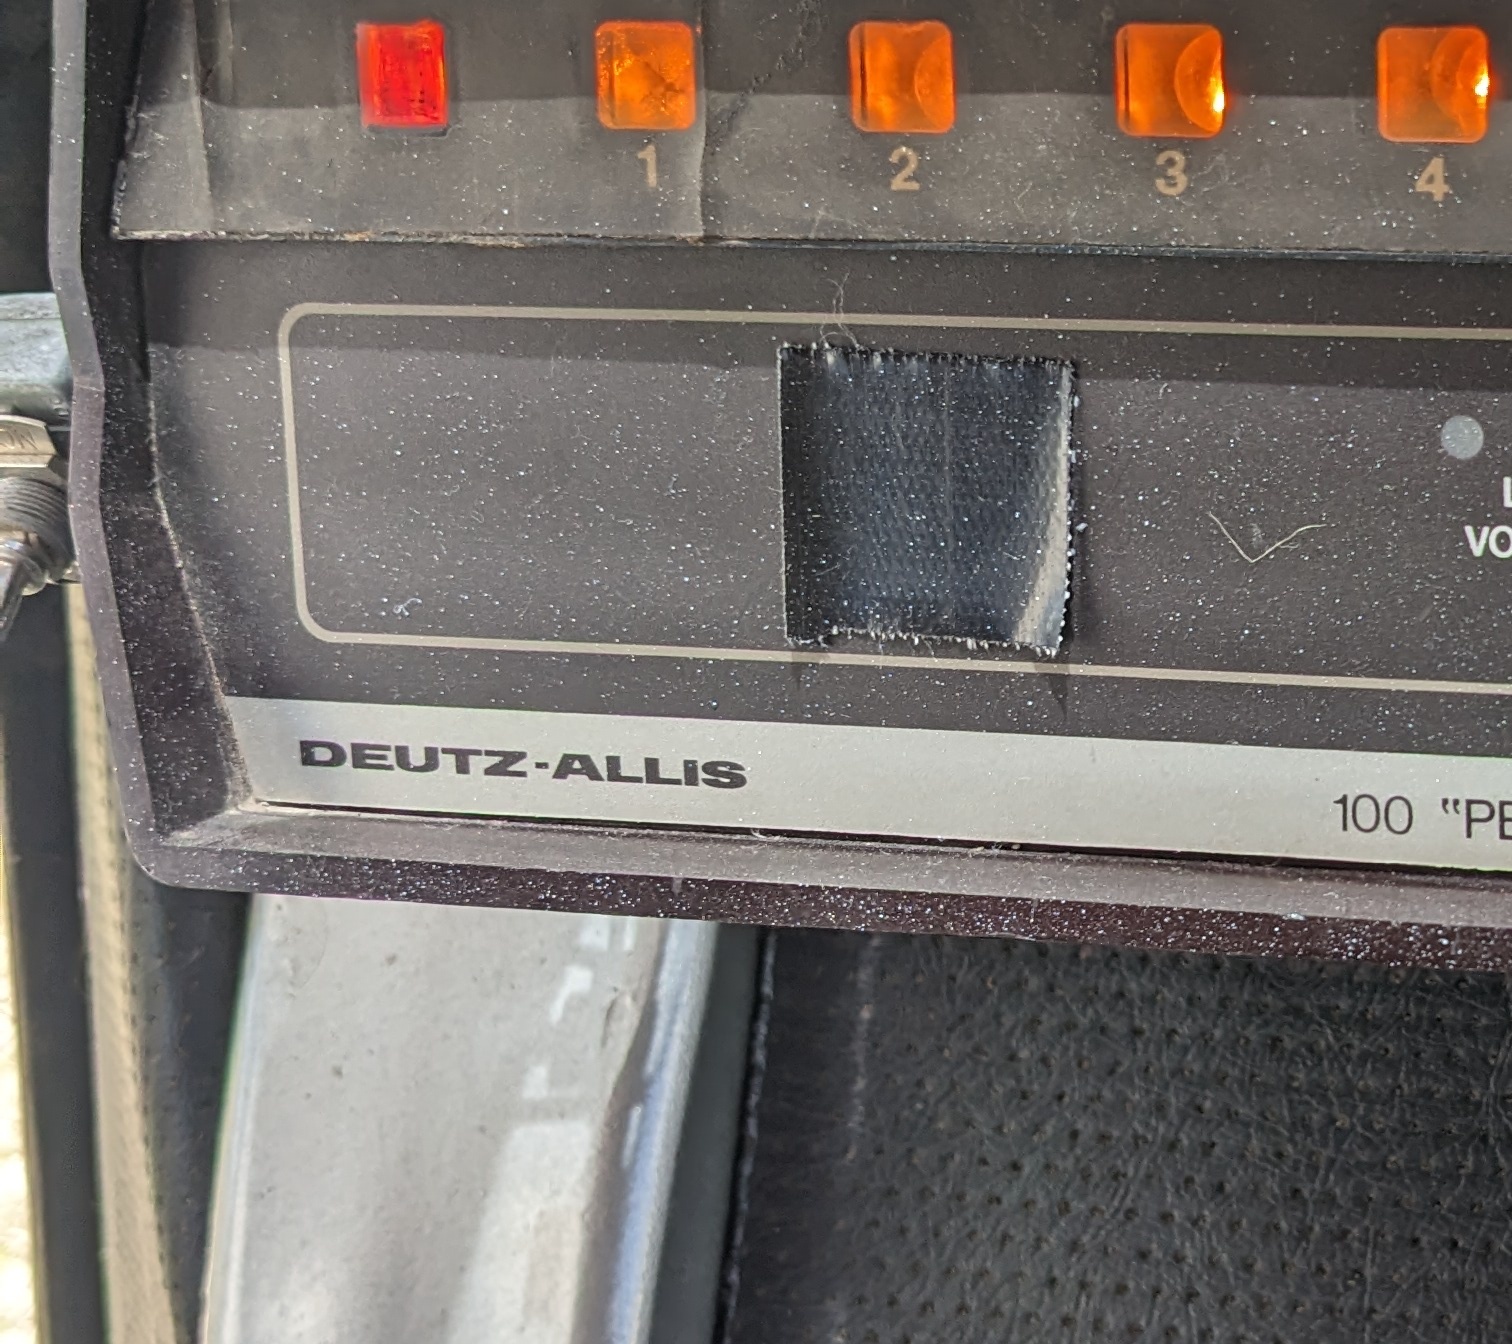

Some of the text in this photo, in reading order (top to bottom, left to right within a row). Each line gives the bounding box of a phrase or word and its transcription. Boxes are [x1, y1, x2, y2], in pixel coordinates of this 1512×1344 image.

[637, 143, 657, 188] 1
[889, 147, 920, 191] 2
[1155, 151, 1189, 196] 3
[1415, 156, 1449, 201] 4
[299, 739, 748, 789] DEUTZ-ALLIS
[1332, 793, 1415, 835] 100
